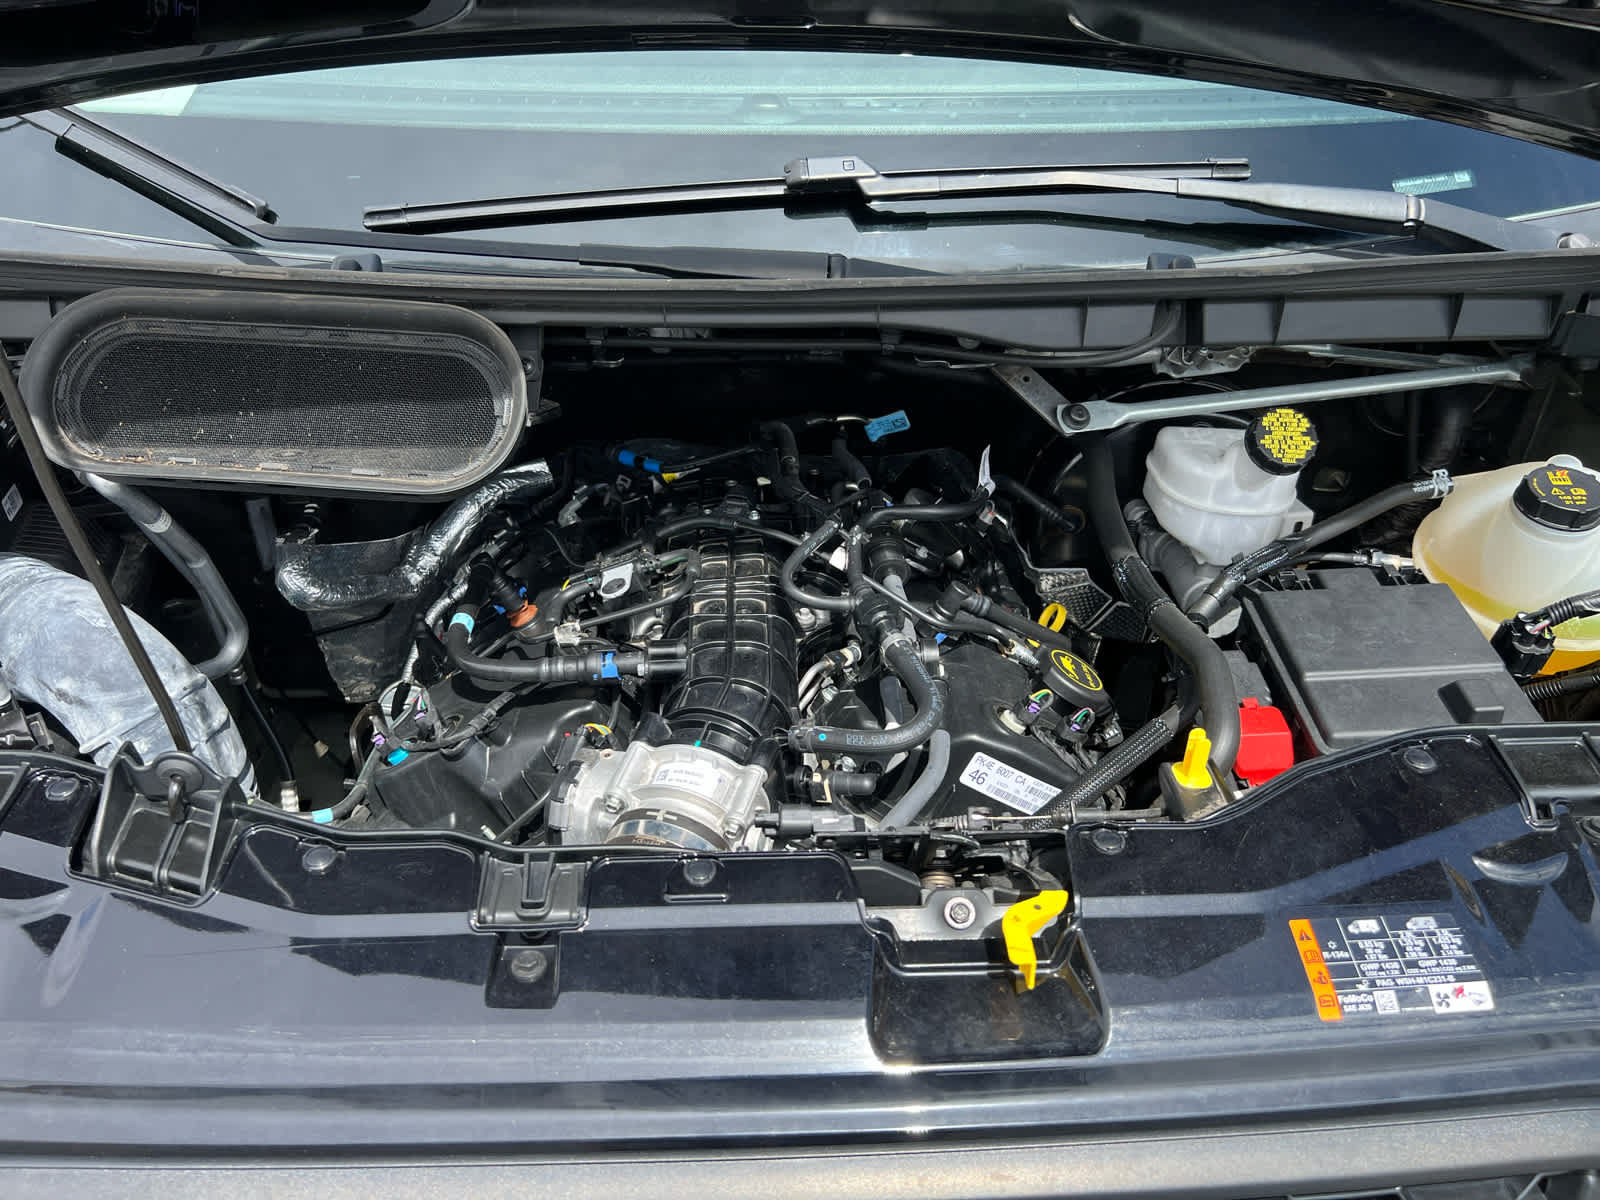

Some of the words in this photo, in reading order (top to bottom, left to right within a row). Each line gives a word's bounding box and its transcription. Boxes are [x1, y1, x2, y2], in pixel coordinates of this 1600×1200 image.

[968, 769, 988, 785] 46
[1015, 775, 1027, 785] CA
[1418, 959, 1437, 967] GWP
[1337, 993, 1373, 1003] FoMoCo
